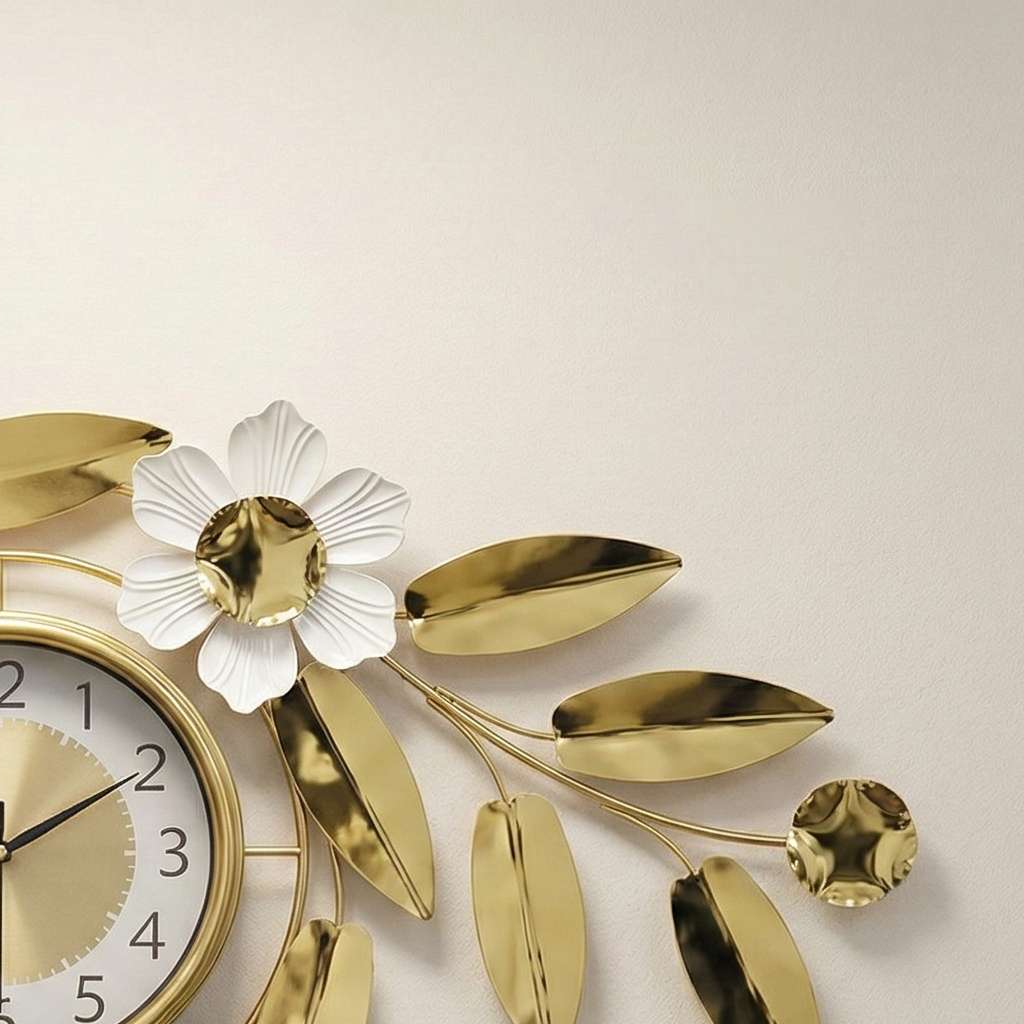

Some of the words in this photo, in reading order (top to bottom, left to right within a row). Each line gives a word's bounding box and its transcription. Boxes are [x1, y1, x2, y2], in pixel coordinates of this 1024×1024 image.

[76, 681, 92, 730] 1
[134, 743, 167, 792] 2
[159, 827, 189, 878] 3
[129, 911, 166, 960] 4
[74, 975, 105, 1024] 5
